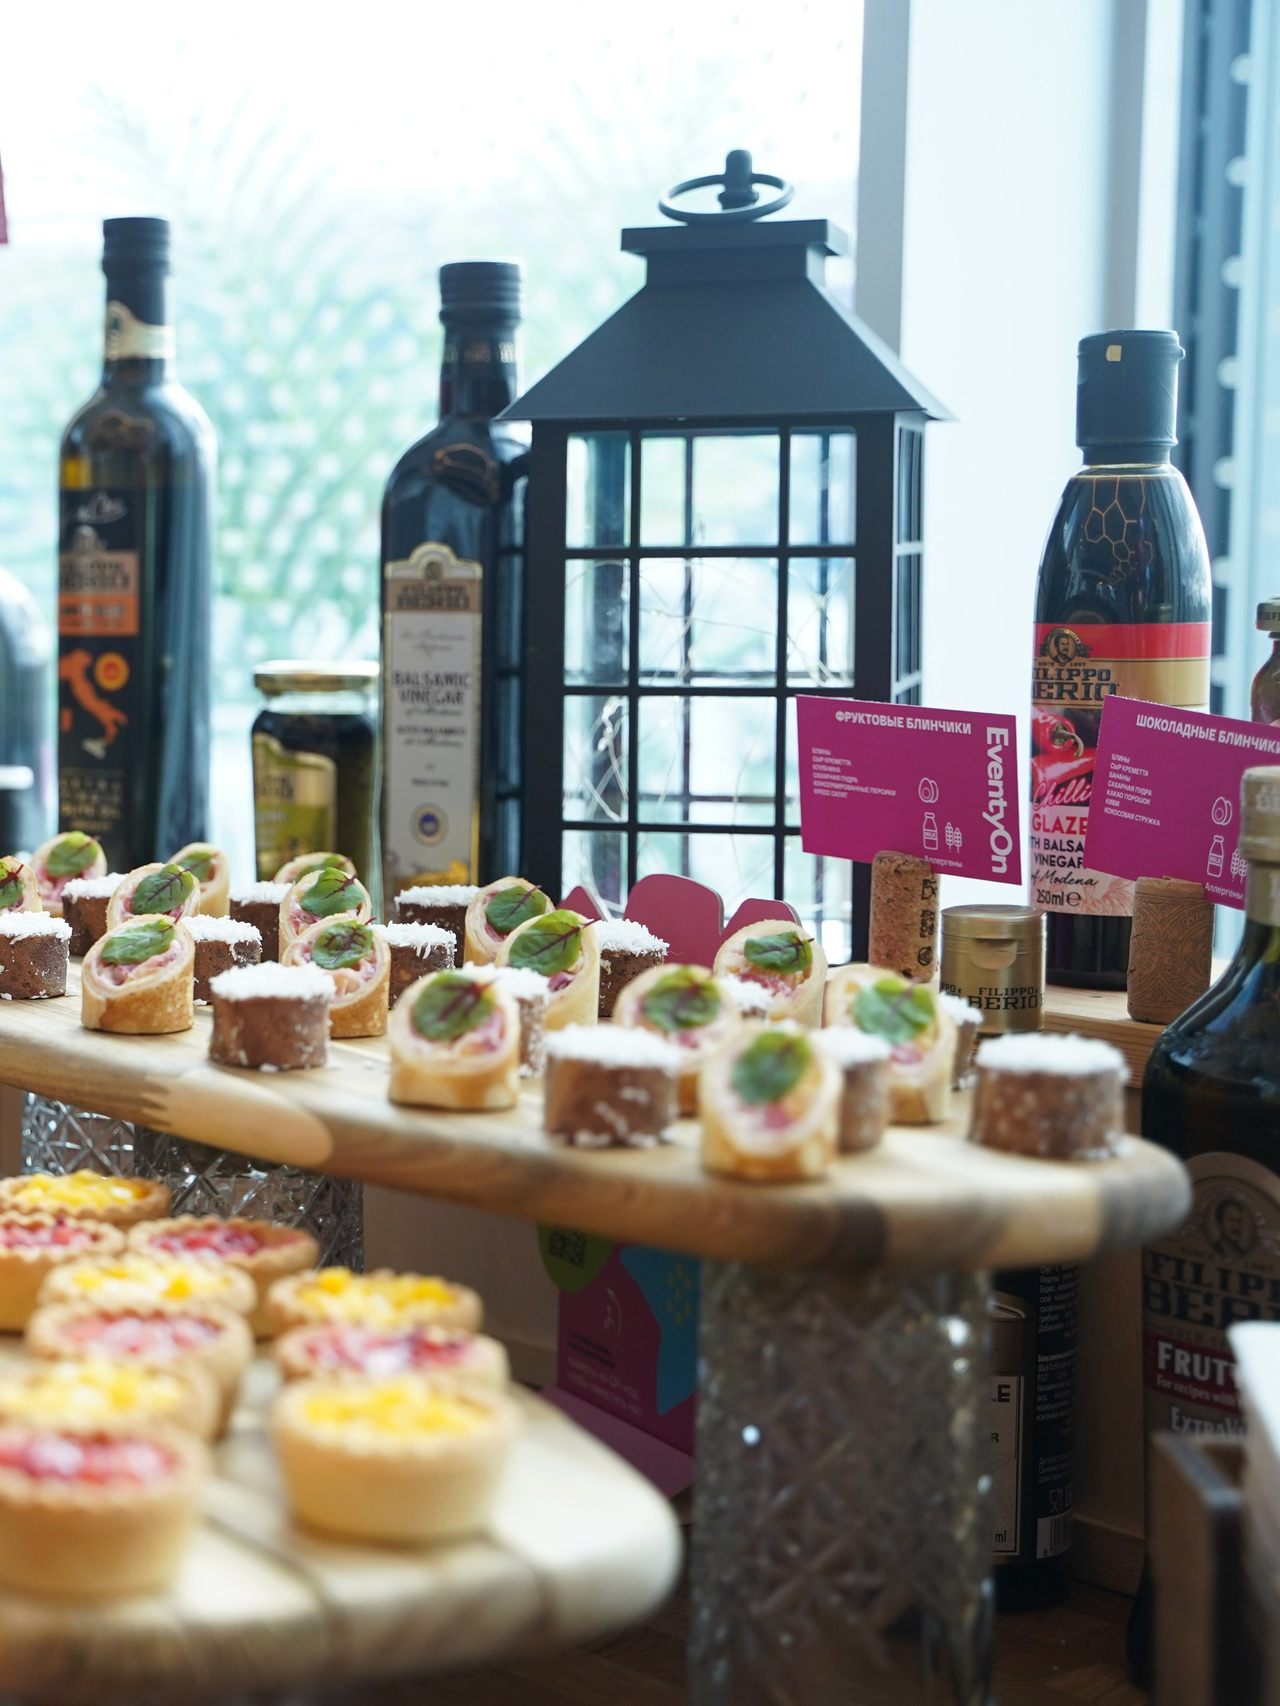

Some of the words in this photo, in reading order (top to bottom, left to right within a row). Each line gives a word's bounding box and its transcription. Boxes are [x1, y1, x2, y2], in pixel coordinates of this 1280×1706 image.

[835, 711, 904, 728] ФРУКТОВЫЕ
[906, 717, 972, 735] БЛИНЧИКИ
[1136, 713, 1216, 741] ШОКОЛАДНЫЕ
[1111, 754, 1130, 763] БЛИНЫ
[1109, 771, 1131, 782] БАНАНЫ
[1122, 764, 1149, 777] КРЕМЕТТА
[1032, 778, 1092, 811] Chilli
[1108, 780, 1135, 792] САХАРНАЯ
[1135, 786, 1152, 796] ПУДРА
[982, 727, 1013, 873] EventyOn
[1105, 798, 1120, 807] КИВИ
[1106, 789, 1124, 799] КАКАО
[1124, 793, 1151, 805] ПОРОШОК
[1032, 813, 1088, 835] GLAZE
[1104, 807, 1135, 820] КОКОСОВАЯ
[1135, 814, 1160, 826] СТРУЖКА
[1043, 839, 1084, 853] BALSA
[924, 855, 963, 868] Аллергены
[1209, 855, 1223, 864] MILK
[1040, 870, 1099, 886] Modena
[1204, 881, 1243, 900] Аллергены
[978, 986, 1034, 996] FILIPPO
[967, 995, 1038, 1009] BERIO
[1142, 1276, 1280, 1331] BER
